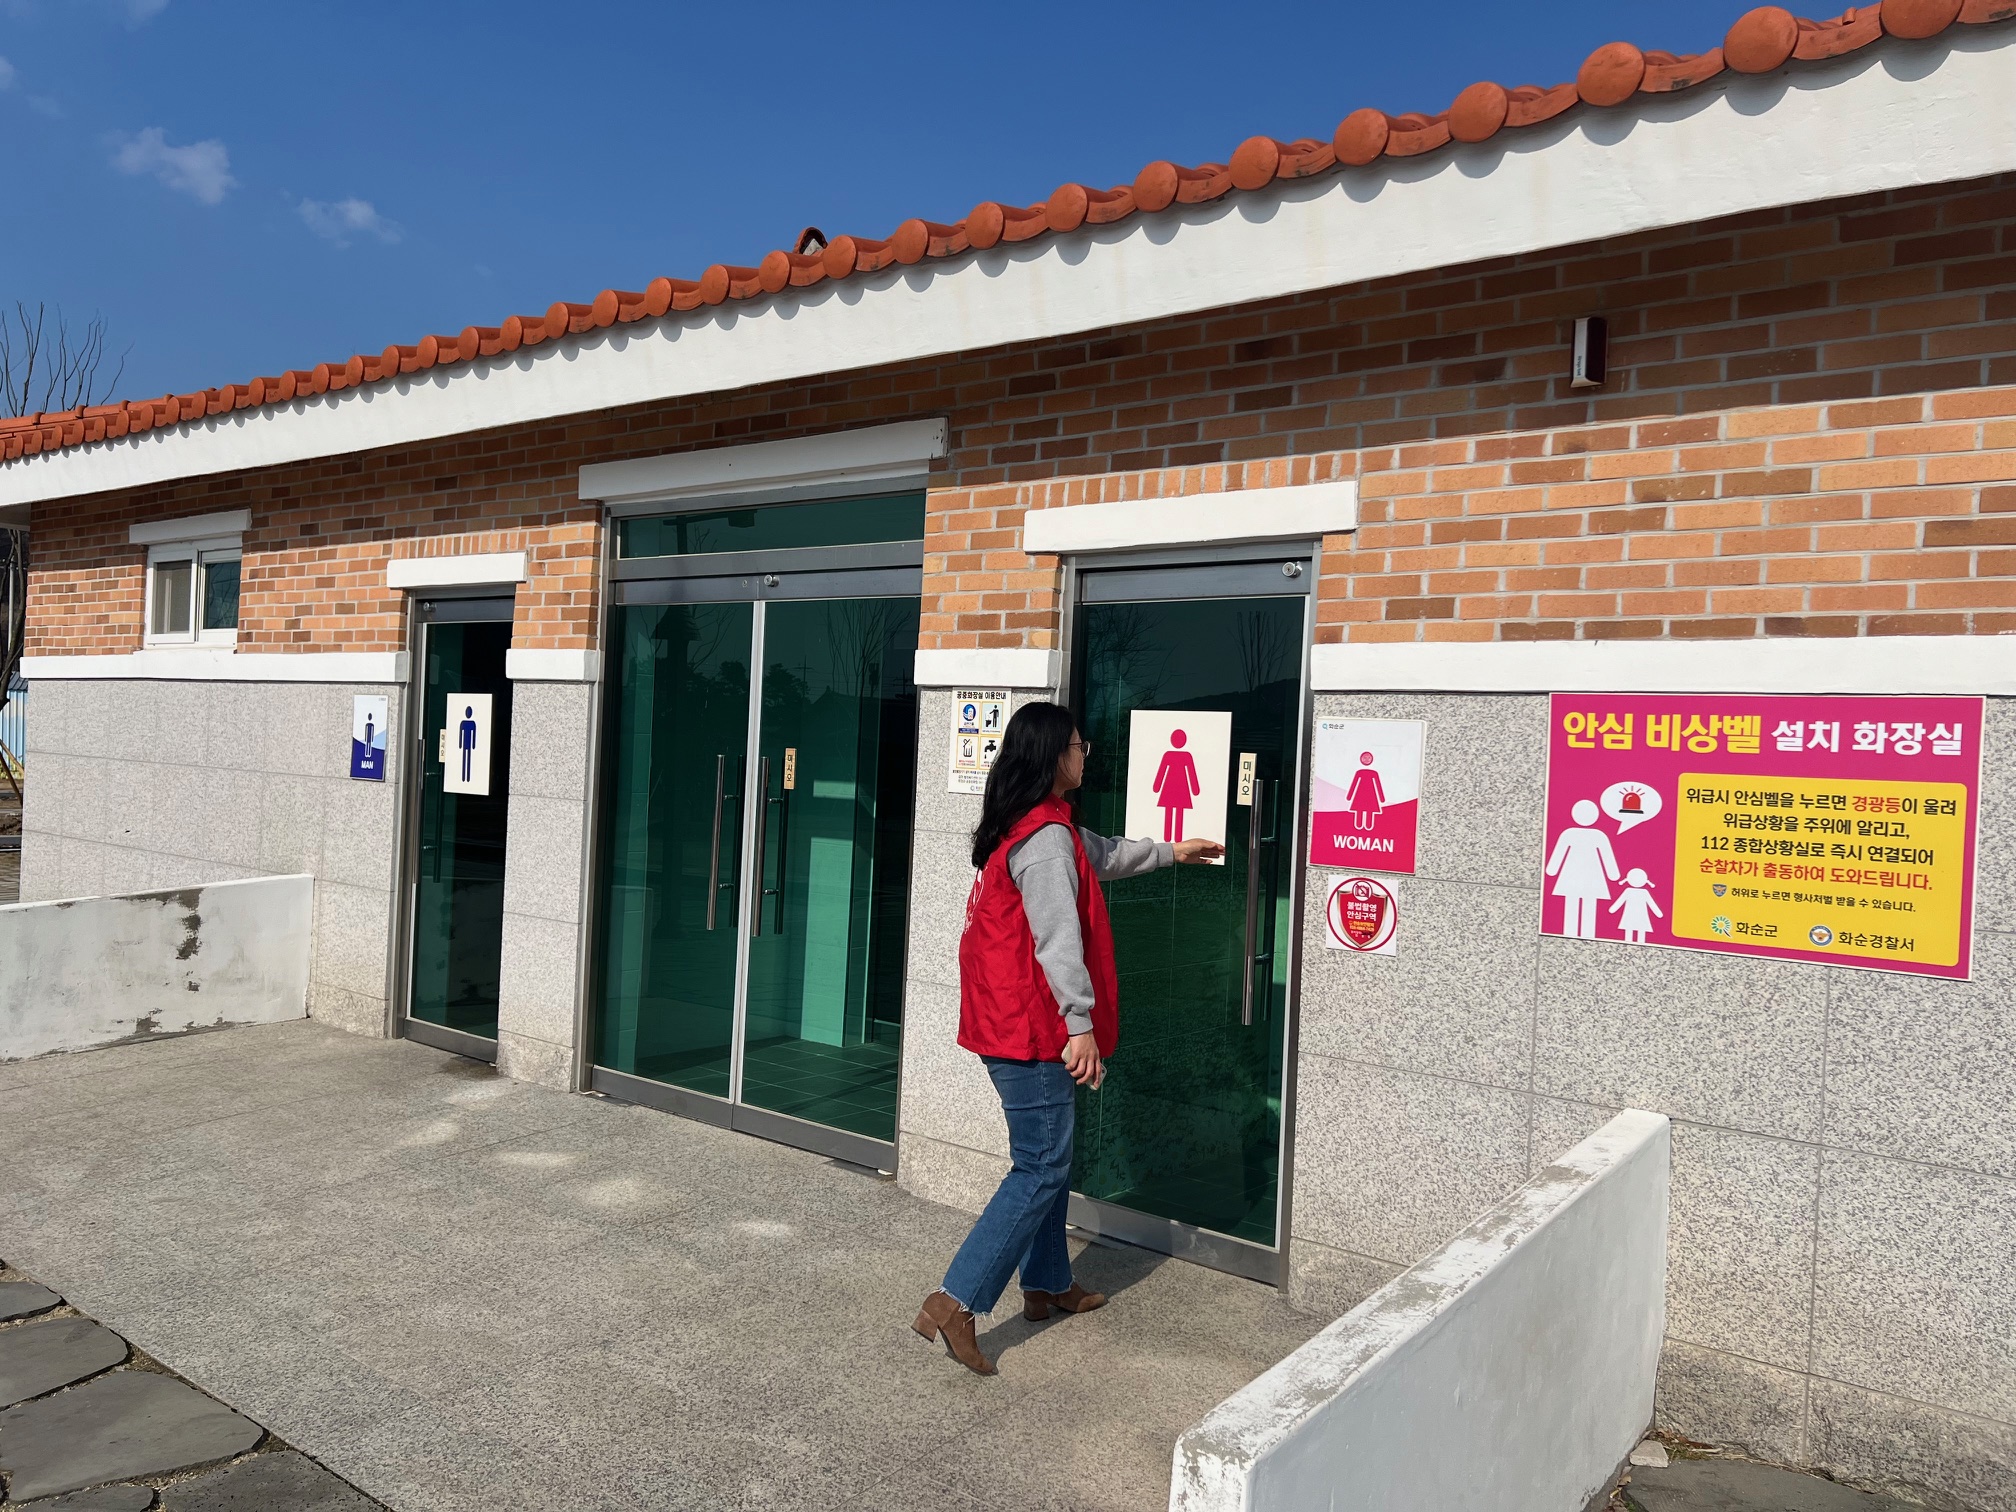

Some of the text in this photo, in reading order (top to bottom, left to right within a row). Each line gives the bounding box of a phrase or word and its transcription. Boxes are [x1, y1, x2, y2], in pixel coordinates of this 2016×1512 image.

[1563, 711, 1963, 756] 안심 비상벨 설치 화장실
[361, 760, 374, 770] MAN
[1241, 761, 1252, 796] 미시오
[1686, 788, 1957, 816] 위급시 안심벨을 누르면 경광등이 울려
[1723, 813, 1910, 840] 위급상황을 주위에 알리고,
[1333, 834, 1394, 852] WOMAN
[1701, 836, 1934, 865] 112 종합상황실로 즉시 연결되어
[1700, 858, 1932, 890] 순찰차가 출동하여 도와드립니다.
[1731, 887, 1916, 912] 허위로 누르면 형사처벌 받을 수 있습니다.
[1346, 910, 1376, 921] 안심구역
[1736, 922, 1778, 938] 화순군
[1838, 931, 1914, 952] 화순경찰서
